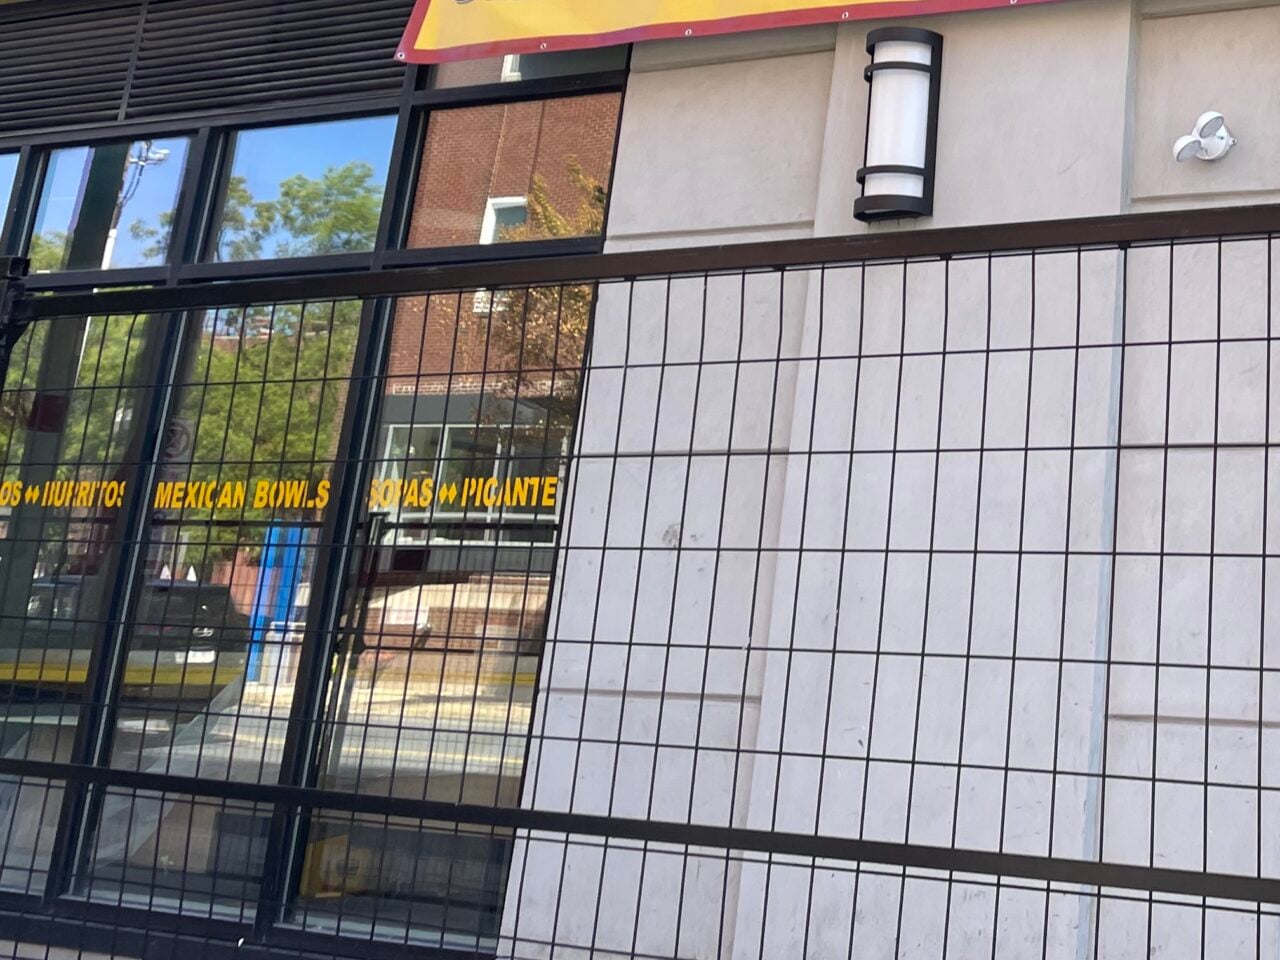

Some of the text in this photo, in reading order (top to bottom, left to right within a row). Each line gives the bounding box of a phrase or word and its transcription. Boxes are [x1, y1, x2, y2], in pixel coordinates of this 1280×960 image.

[41, 480, 127, 507] BURRITOS
[154, 480, 331, 509] MEXICAN BOWLS
[460, 476, 558, 507] PICANTE
